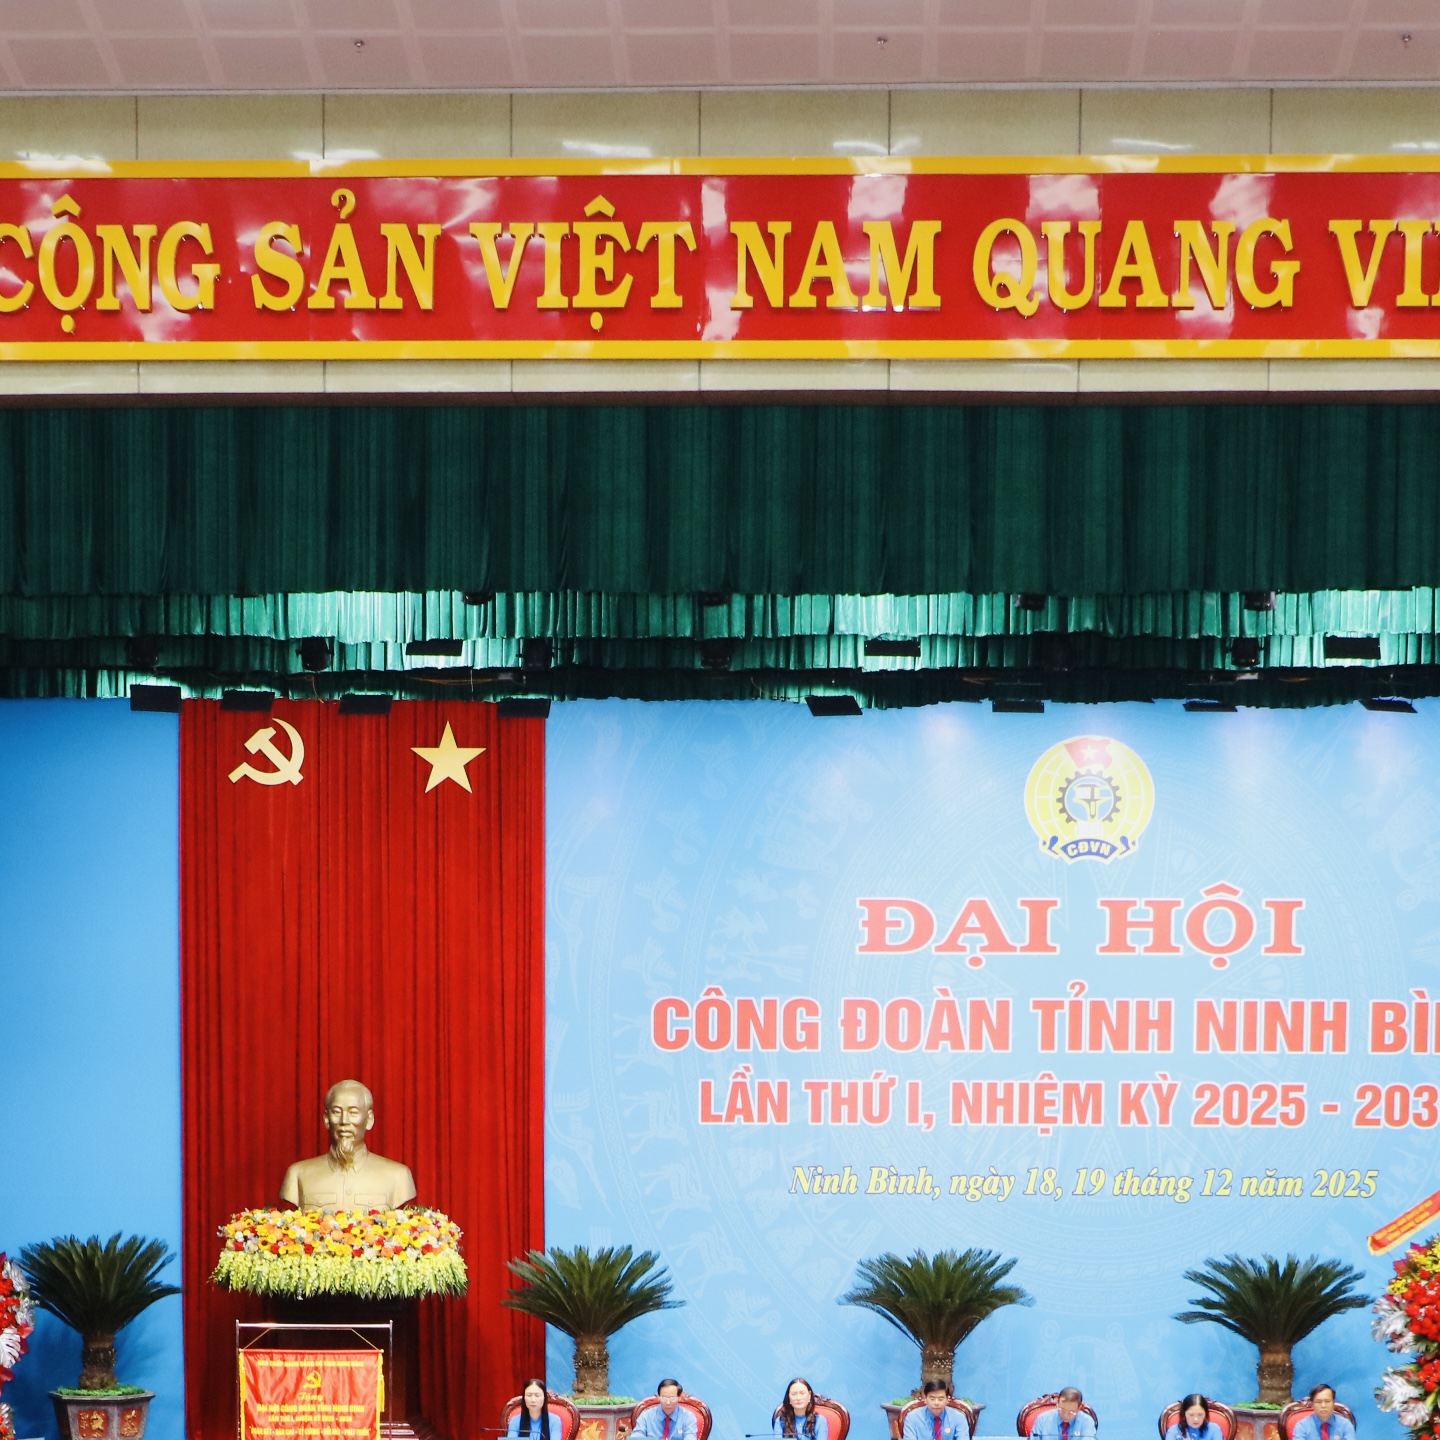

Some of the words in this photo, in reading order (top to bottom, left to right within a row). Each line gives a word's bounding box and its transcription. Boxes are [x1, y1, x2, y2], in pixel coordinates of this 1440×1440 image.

[250, 187, 442, 311] SẢN
[465, 194, 700, 333] VIỆT
[729, 218, 943, 310] NAM
[971, 216, 1298, 321] QUANG
[1067, 841, 1110, 857] CĐVN
[856, 897, 1058, 969] ĐẠI
[1097, 882, 1305, 969] HỘI
[651, 987, 822, 1052] CÔNG
[839, 987, 1011, 1053] ĐOÀN
[1032, 980, 1173, 1054] TỈNH
[1194, 998, 1348, 1055] NINH
[698, 1065, 789, 1126] LẦN
[803, 1073, 897, 1126] THỨ
[907, 1079, 935, 1132] I,
[950, 1073, 1104, 1135] NHIỆM
[1118, 1071, 1179, 1128] KỲ
[1192, 1083, 1307, 1128] 2025
[788, 1167, 859, 1195] Ninh
[866, 1165, 942, 1201] Bình,
[949, 1168, 1015, 1203] ngày
[1023, 1168, 1063, 1201] 18,
[1072, 1168, 1105, 1197] 19
[1112, 1168, 1193, 1204] tháng
[1200, 1169, 1233, 1198] 12
[1240, 1169, 1303, 1198] năm
[1310, 1170, 1379, 1199] 2025
